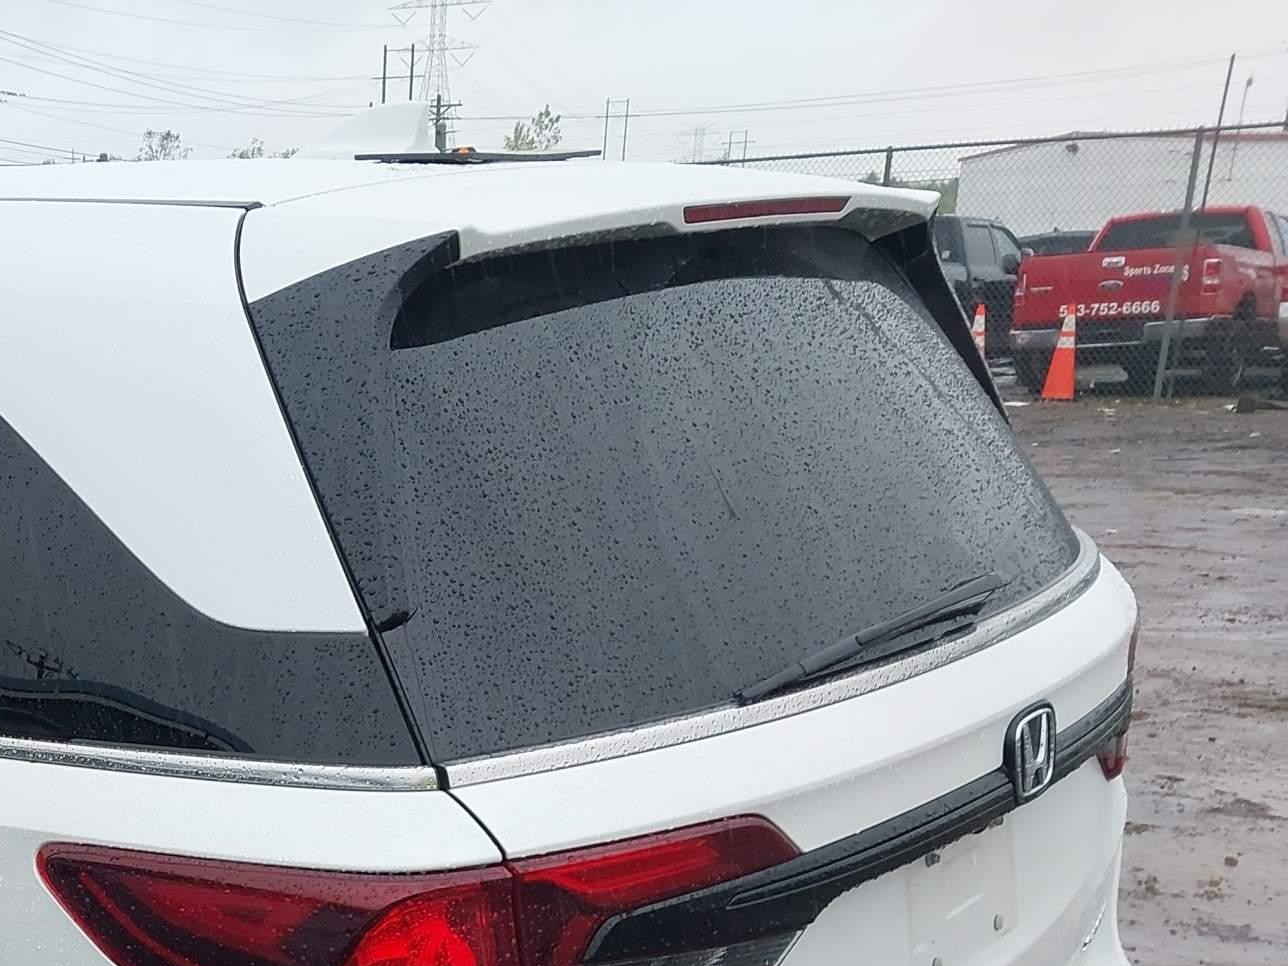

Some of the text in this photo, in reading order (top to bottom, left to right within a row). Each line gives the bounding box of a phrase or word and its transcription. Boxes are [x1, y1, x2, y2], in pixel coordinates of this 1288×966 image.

[1123, 265, 1152, 277] Sports
[1153, 263, 1176, 274] Zone
[1059, 300, 1161, 318] 53-752-6666
